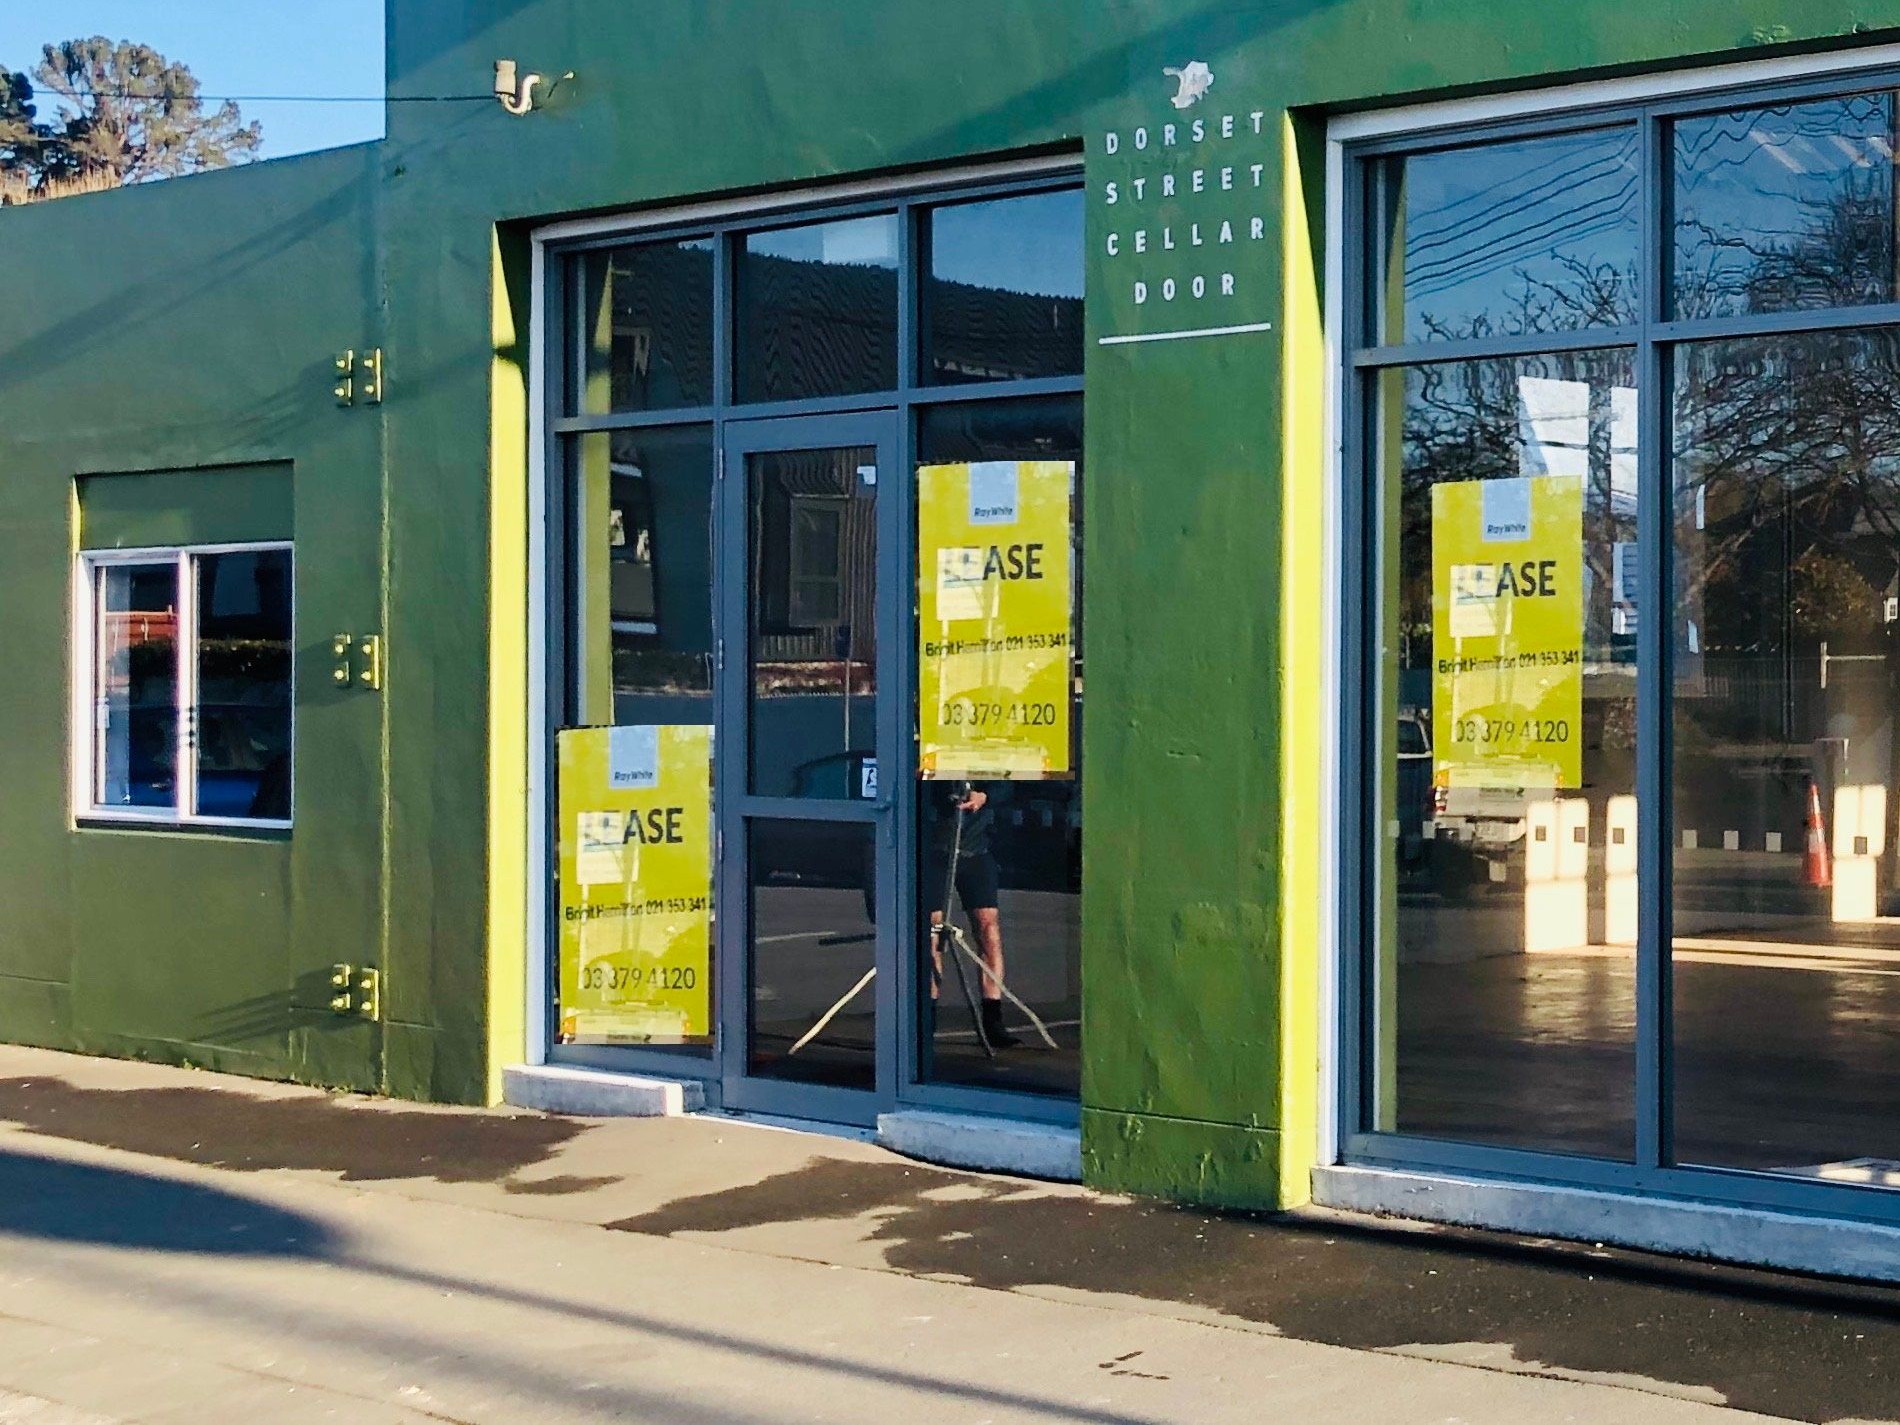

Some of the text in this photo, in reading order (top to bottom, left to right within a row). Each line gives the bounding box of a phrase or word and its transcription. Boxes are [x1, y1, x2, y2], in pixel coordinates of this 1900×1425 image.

[1106, 112, 1264, 155] DORSET
[1105, 164, 1264, 205] STREET
[1106, 217, 1264, 256] CELLAR
[1134, 273, 1235, 305] DOOR
[944, 543, 1044, 583] ASE
[1456, 560, 1557, 600] ASE
[943, 703, 1056, 726] 03 379 4120
[1456, 720, 1569, 743] 03 379 4120
[584, 807, 684, 847] ASE
[583, 967, 696, 989] 03 379 4120
